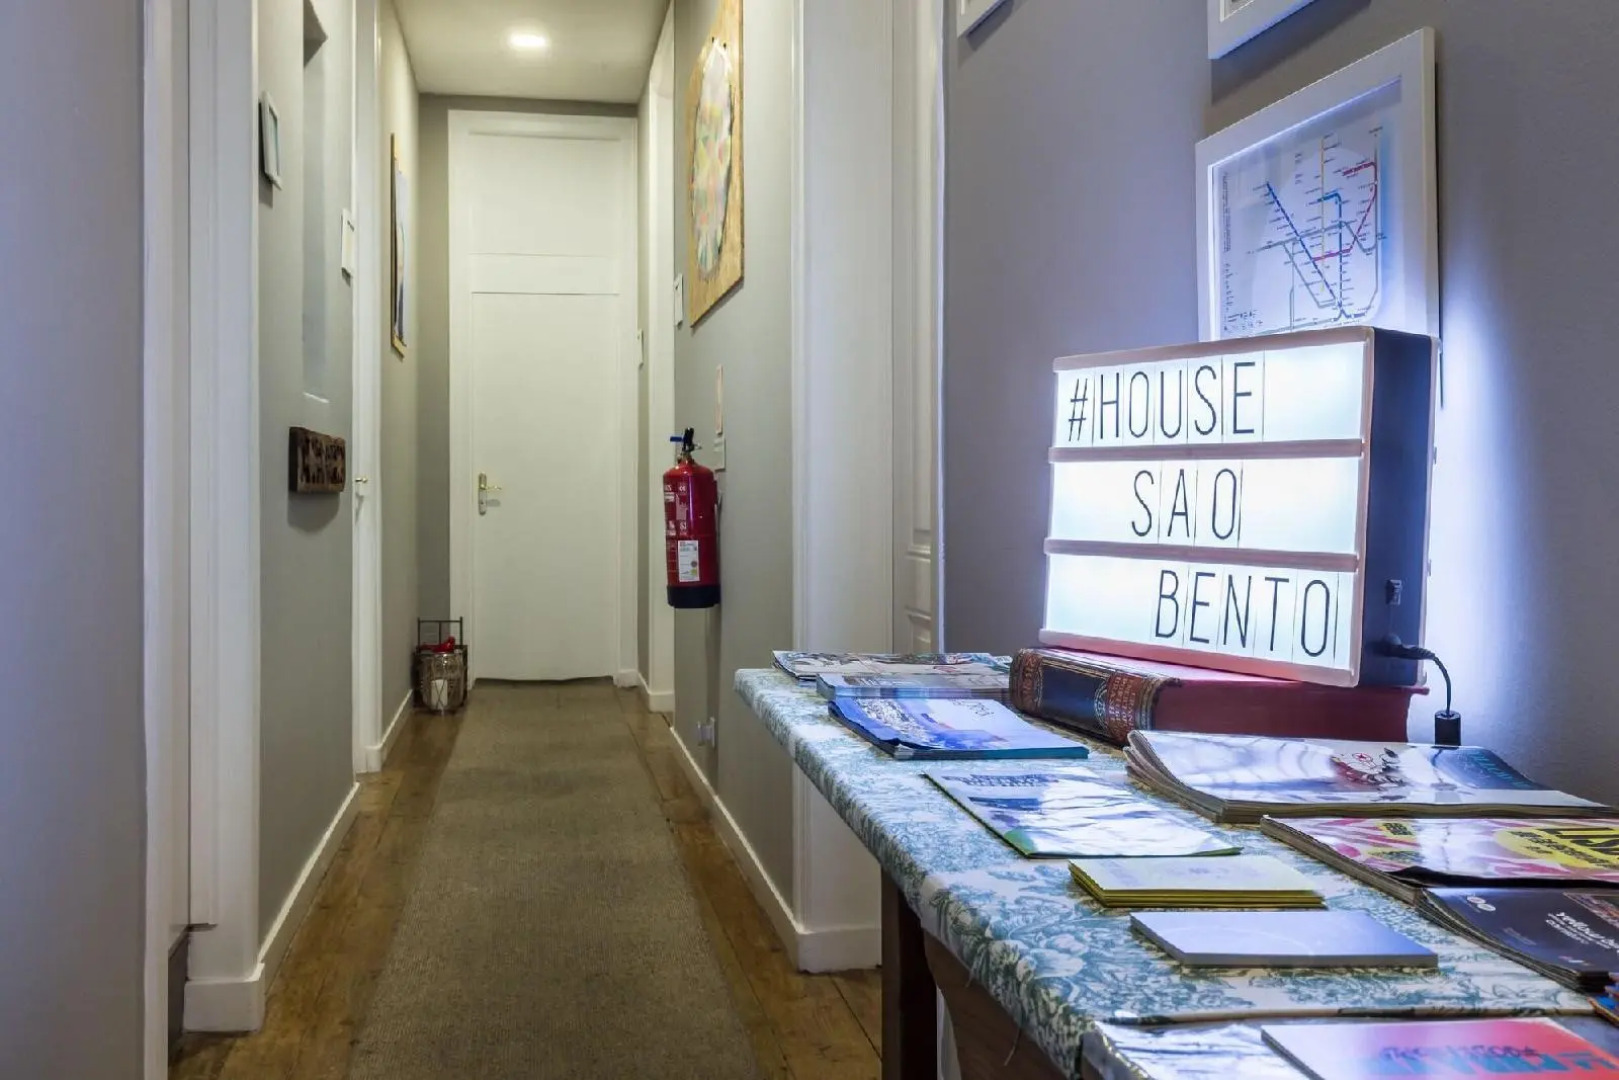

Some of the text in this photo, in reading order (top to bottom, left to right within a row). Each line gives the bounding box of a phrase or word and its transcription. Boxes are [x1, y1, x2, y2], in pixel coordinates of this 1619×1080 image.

[1068, 361, 1256, 442] #HOUSE
[1131, 468, 1238, 541] SAO
[1155, 569, 1331, 657] BENTO
